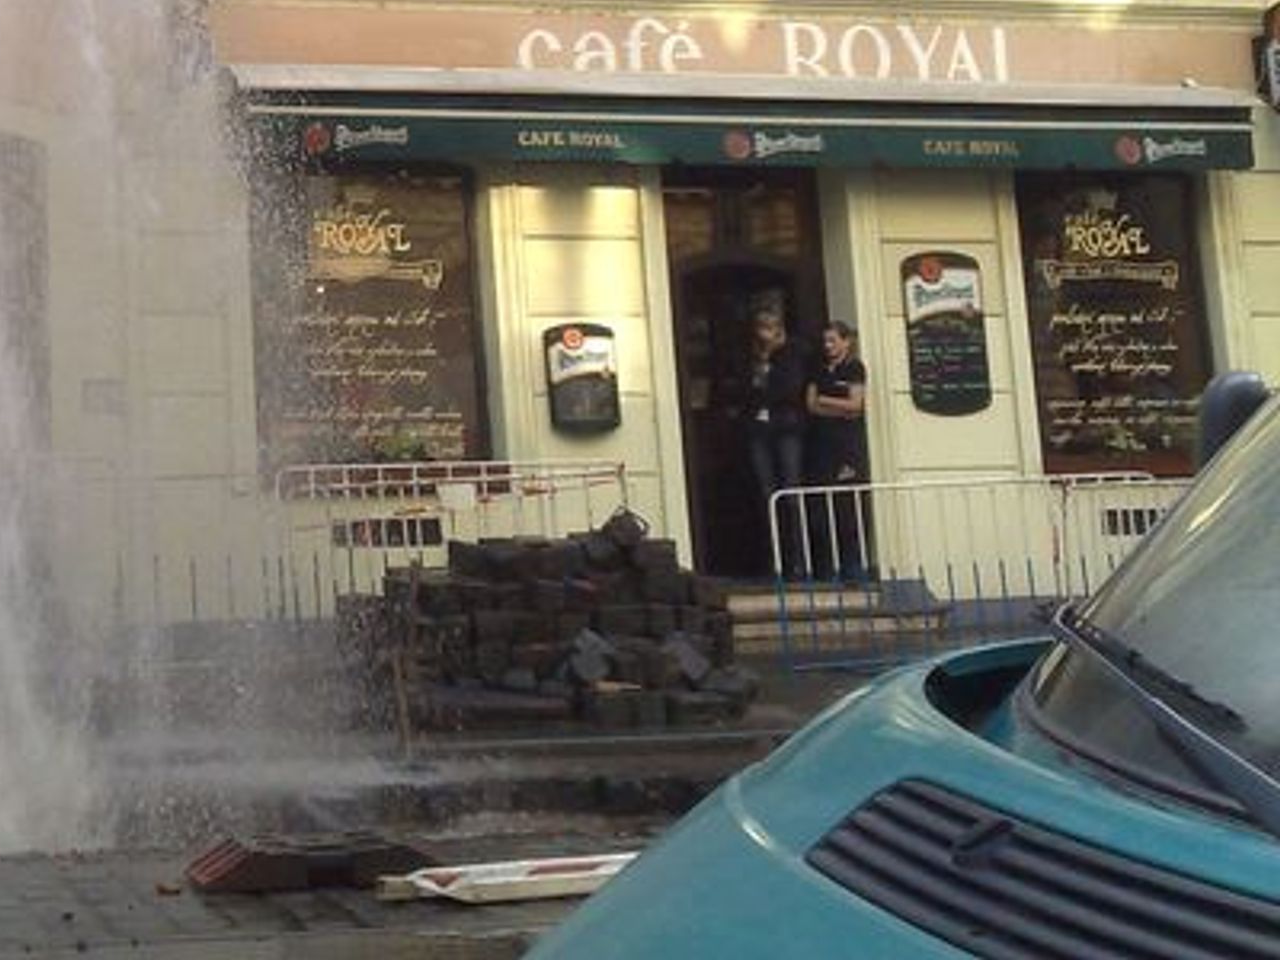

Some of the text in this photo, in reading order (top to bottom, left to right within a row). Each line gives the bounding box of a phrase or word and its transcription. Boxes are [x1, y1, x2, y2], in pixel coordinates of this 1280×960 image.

[517, 18, 703, 74] café
[312, 208, 411, 253] ROYAL
[1065, 213, 1150, 256] ROYAL
